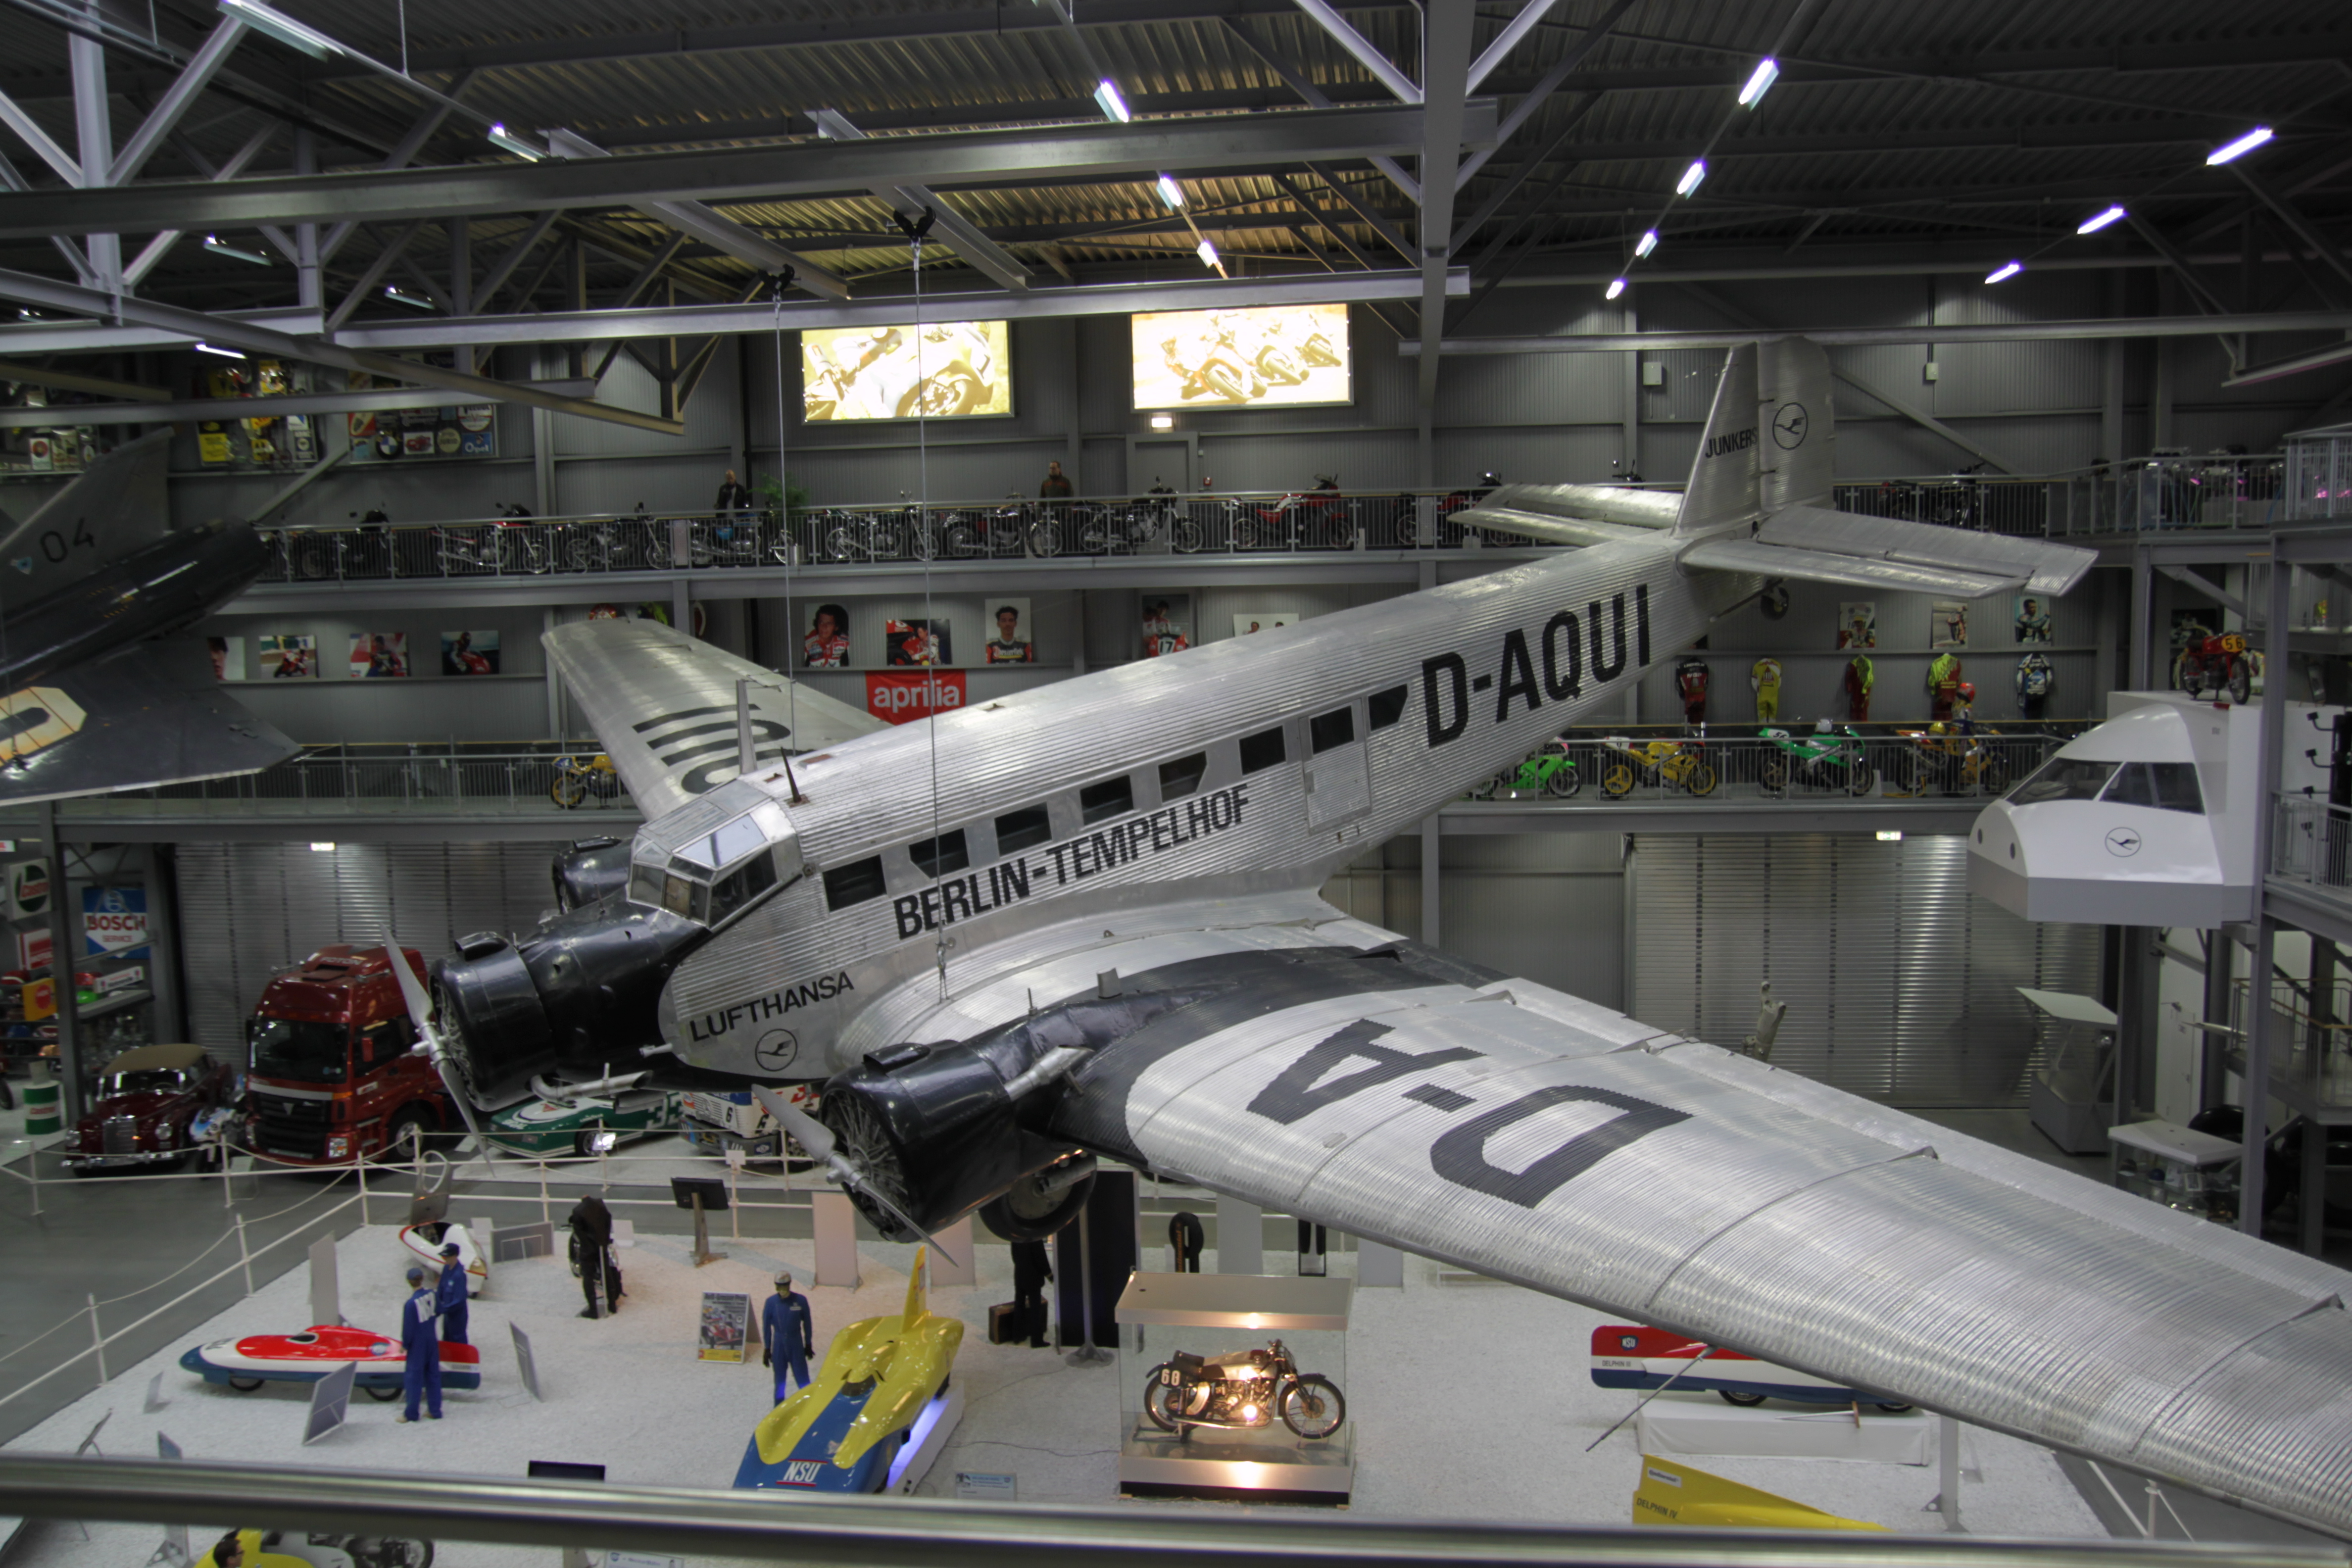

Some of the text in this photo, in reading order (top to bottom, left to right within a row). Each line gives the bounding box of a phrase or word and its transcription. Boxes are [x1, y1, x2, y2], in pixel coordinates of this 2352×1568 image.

[464, 441, 489, 453] Opel
[1705, 426, 1757, 458] JUNKERS
[40, 517, 95, 564] 04
[2225, 637, 2243, 650] 56
[1422, 583, 1651, 749] D-AQUI
[874, 680, 960, 713] aprilia
[892, 783, 1249, 940] BERLIN-TEMPELHOF
[87, 916, 146, 931] BOSCH
[689, 971, 854, 1039] LUFTHANSA
[726, 1107, 733, 1123] 6
[1621, 1337, 1636, 1348] NSU
[784, 1462, 821, 1483] NSU
[1636, 1497, 1668, 1516] DELPHIN
